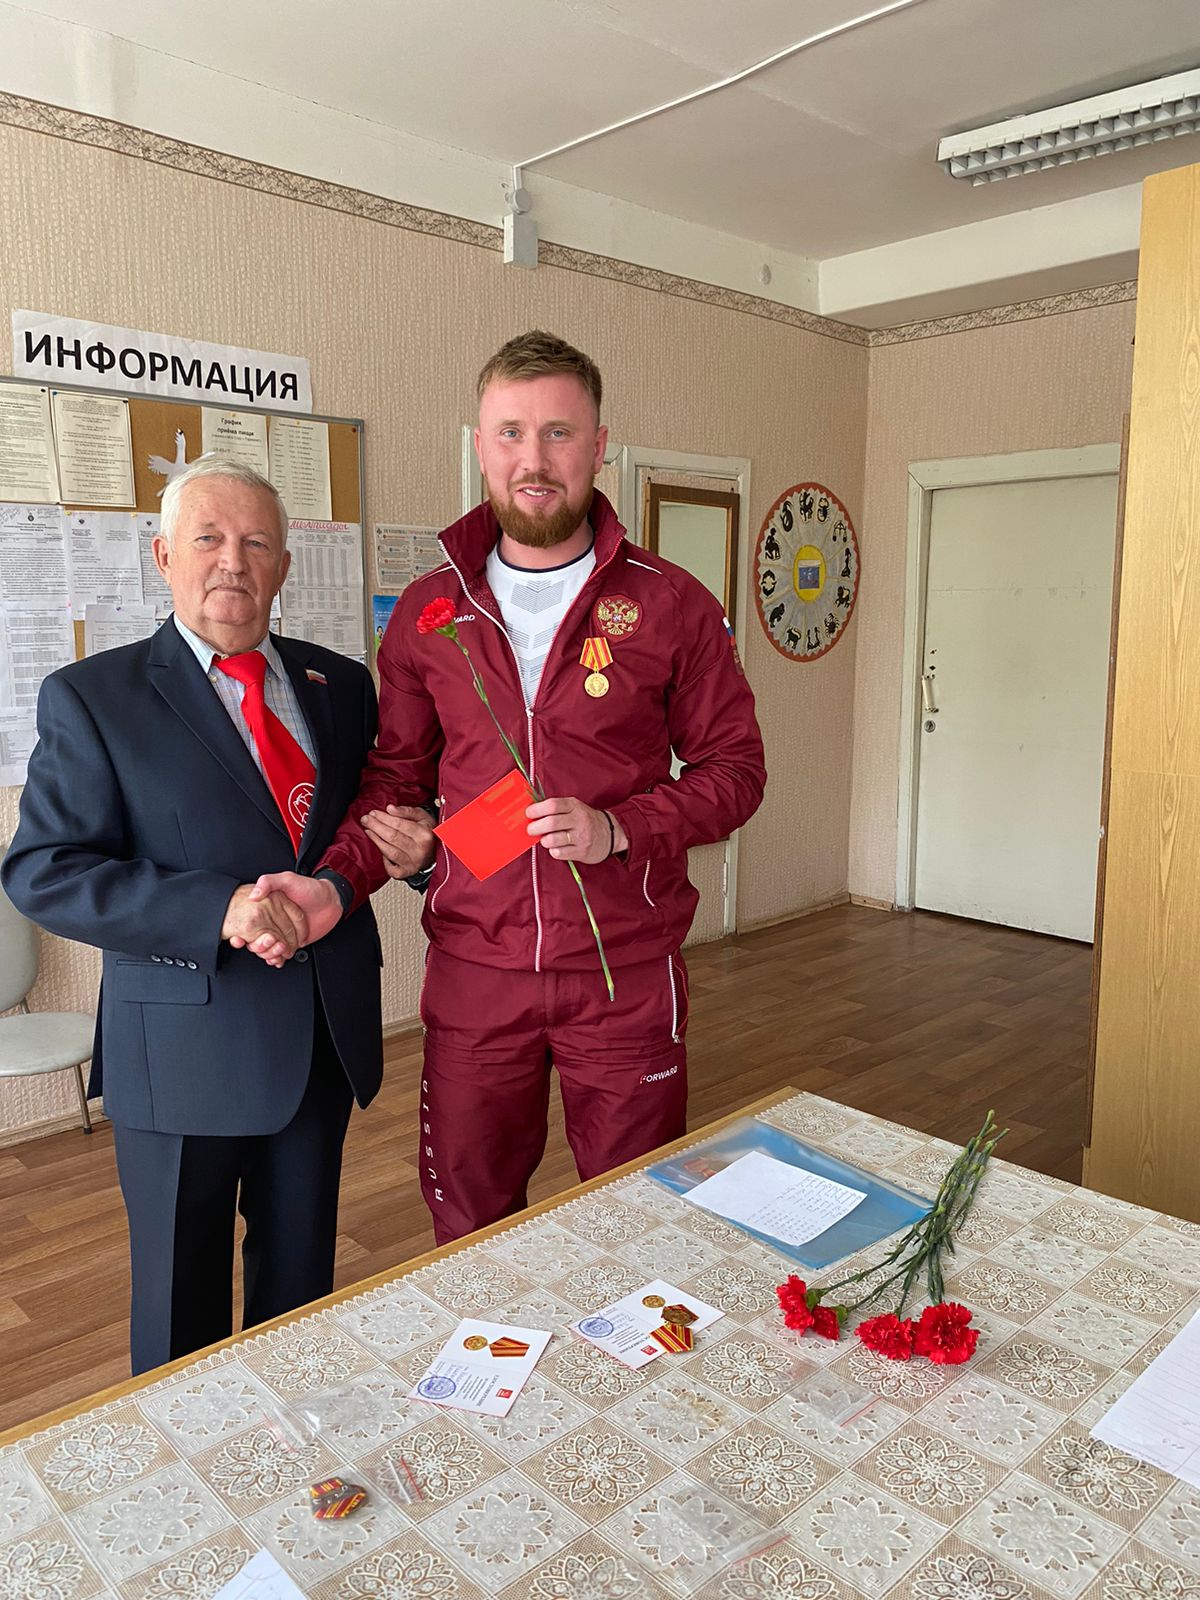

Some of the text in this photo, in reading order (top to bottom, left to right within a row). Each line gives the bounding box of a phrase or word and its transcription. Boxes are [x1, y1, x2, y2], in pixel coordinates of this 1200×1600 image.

[25, 331, 298, 402] ИНФОРМАЦИЯ
[221, 417, 242, 426] График
[639, 1065, 678, 1084] FORWARD
[422, 1079, 444, 1202] RUSSIA
